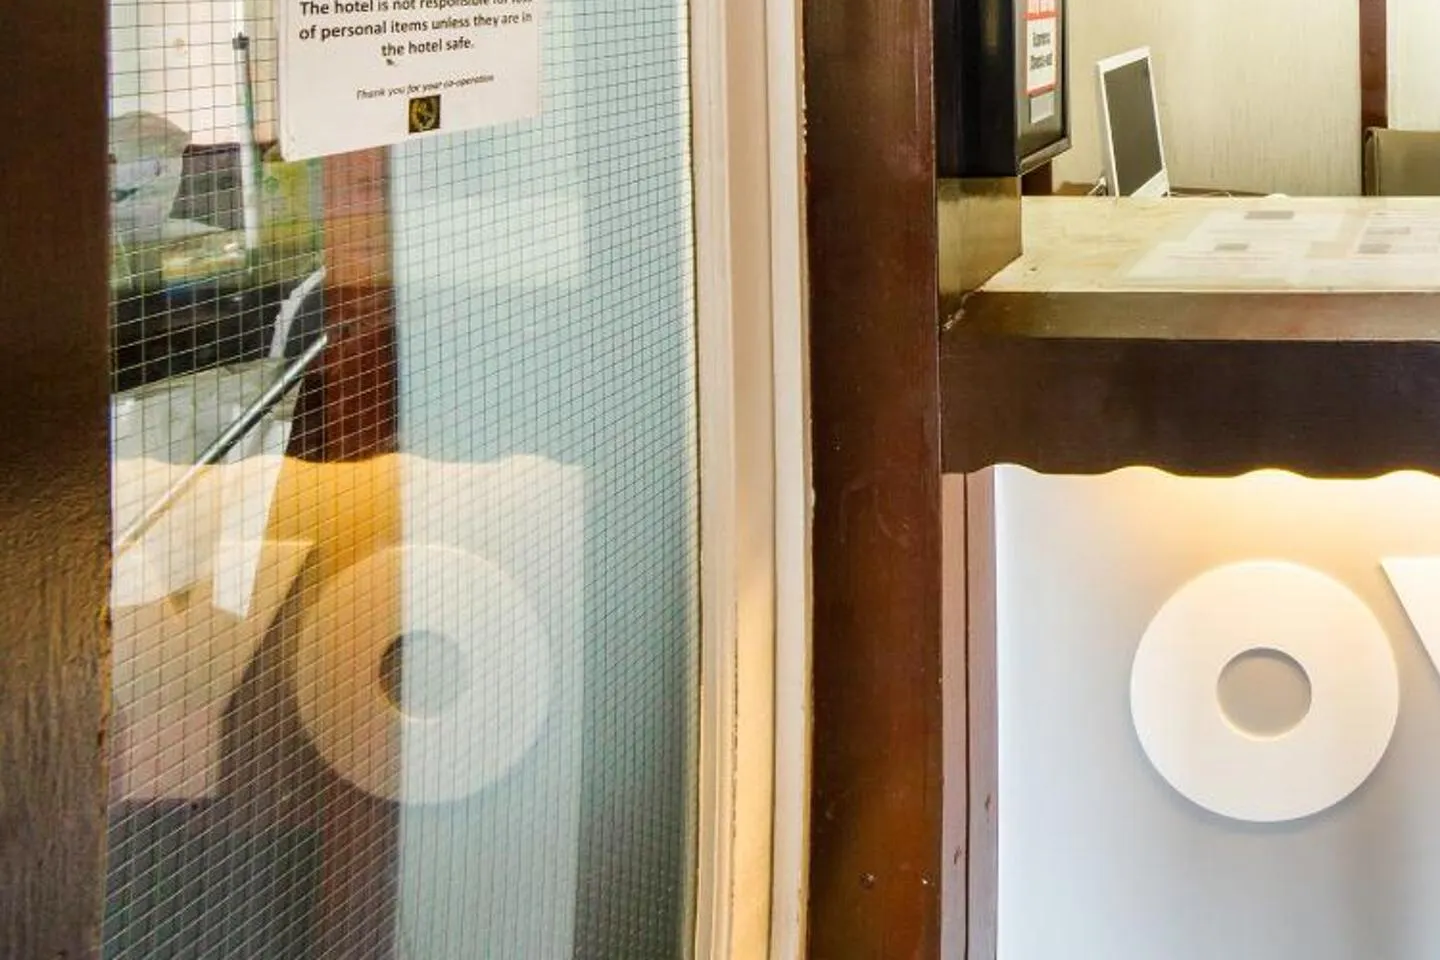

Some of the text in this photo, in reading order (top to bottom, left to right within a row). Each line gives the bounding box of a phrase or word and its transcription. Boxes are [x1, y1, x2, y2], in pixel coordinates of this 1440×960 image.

[299, 0, 330, 16] The
[299, 11, 533, 42] of personal items unless they are in
[381, 35, 475, 57] the hotel safe.
[356, 86, 386, 100] Thank
[387, 85, 406, 97] you
[406, 82, 421, 95] for
[422, 81, 443, 92] your
